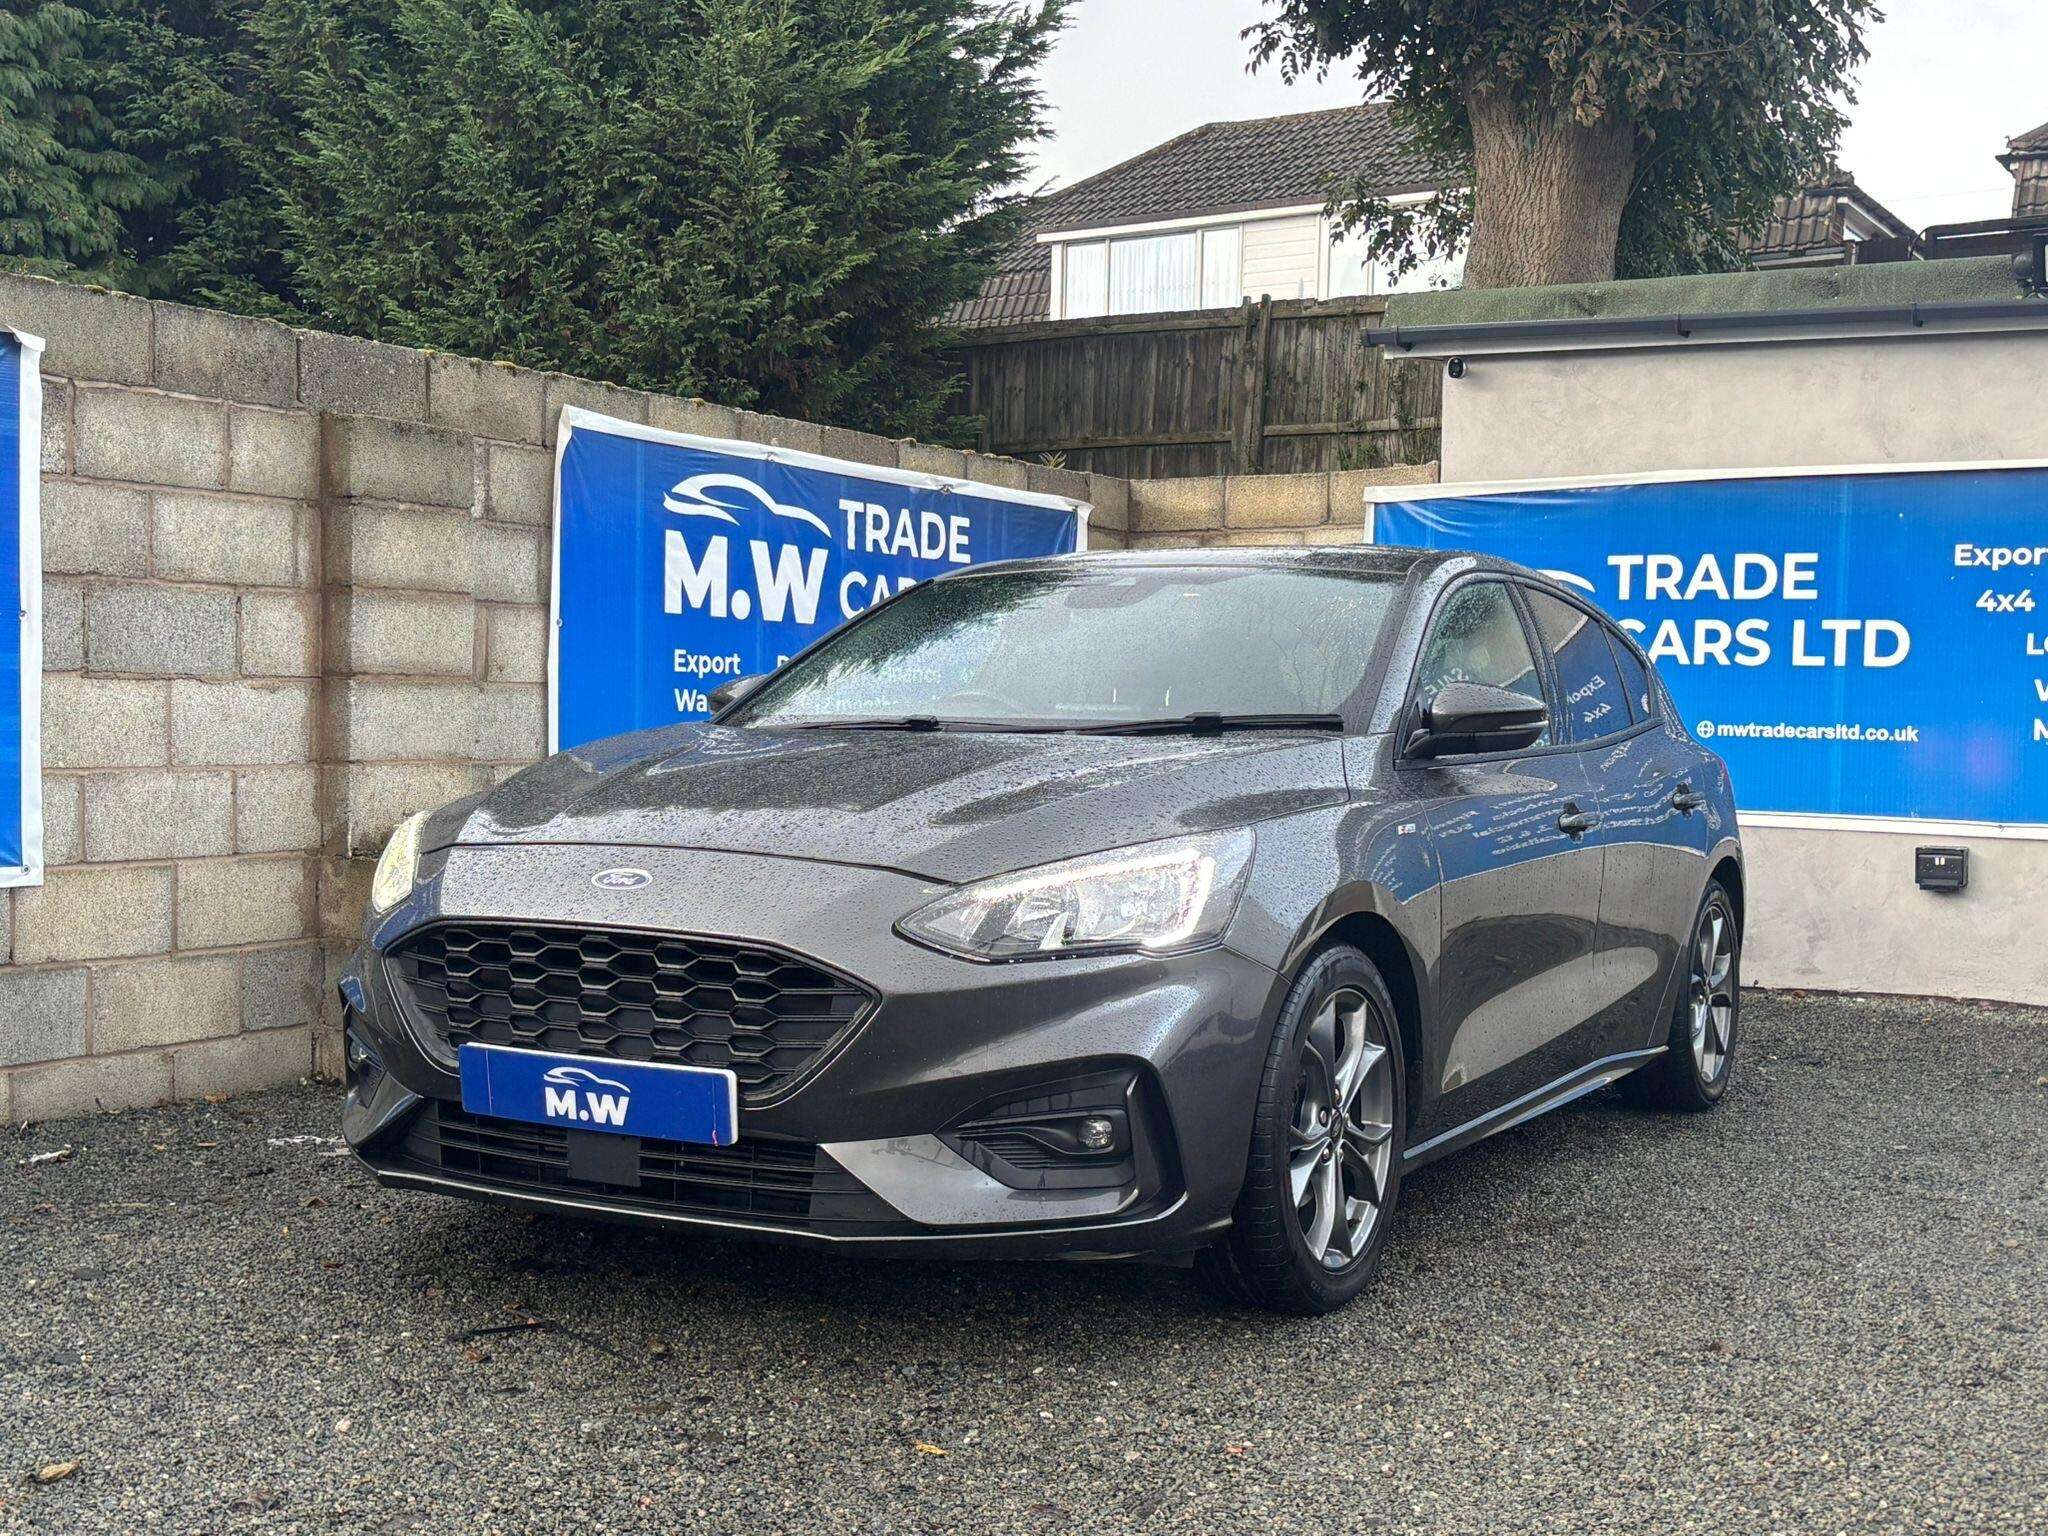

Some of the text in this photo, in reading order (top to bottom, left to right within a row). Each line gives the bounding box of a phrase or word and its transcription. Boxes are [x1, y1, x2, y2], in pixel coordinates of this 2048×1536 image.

[839, 498, 971, 564] TRADE
[664, 529, 829, 625] M.W
[1607, 552, 1819, 600] TRADE
[1976, 589, 2036, 612] 4x4
[674, 648, 741, 679] Export
[1792, 619, 1911, 667] LTD
[1717, 722, 1919, 743] mwtradecarsltd.co.uk
[545, 1086, 630, 1126] M.W
